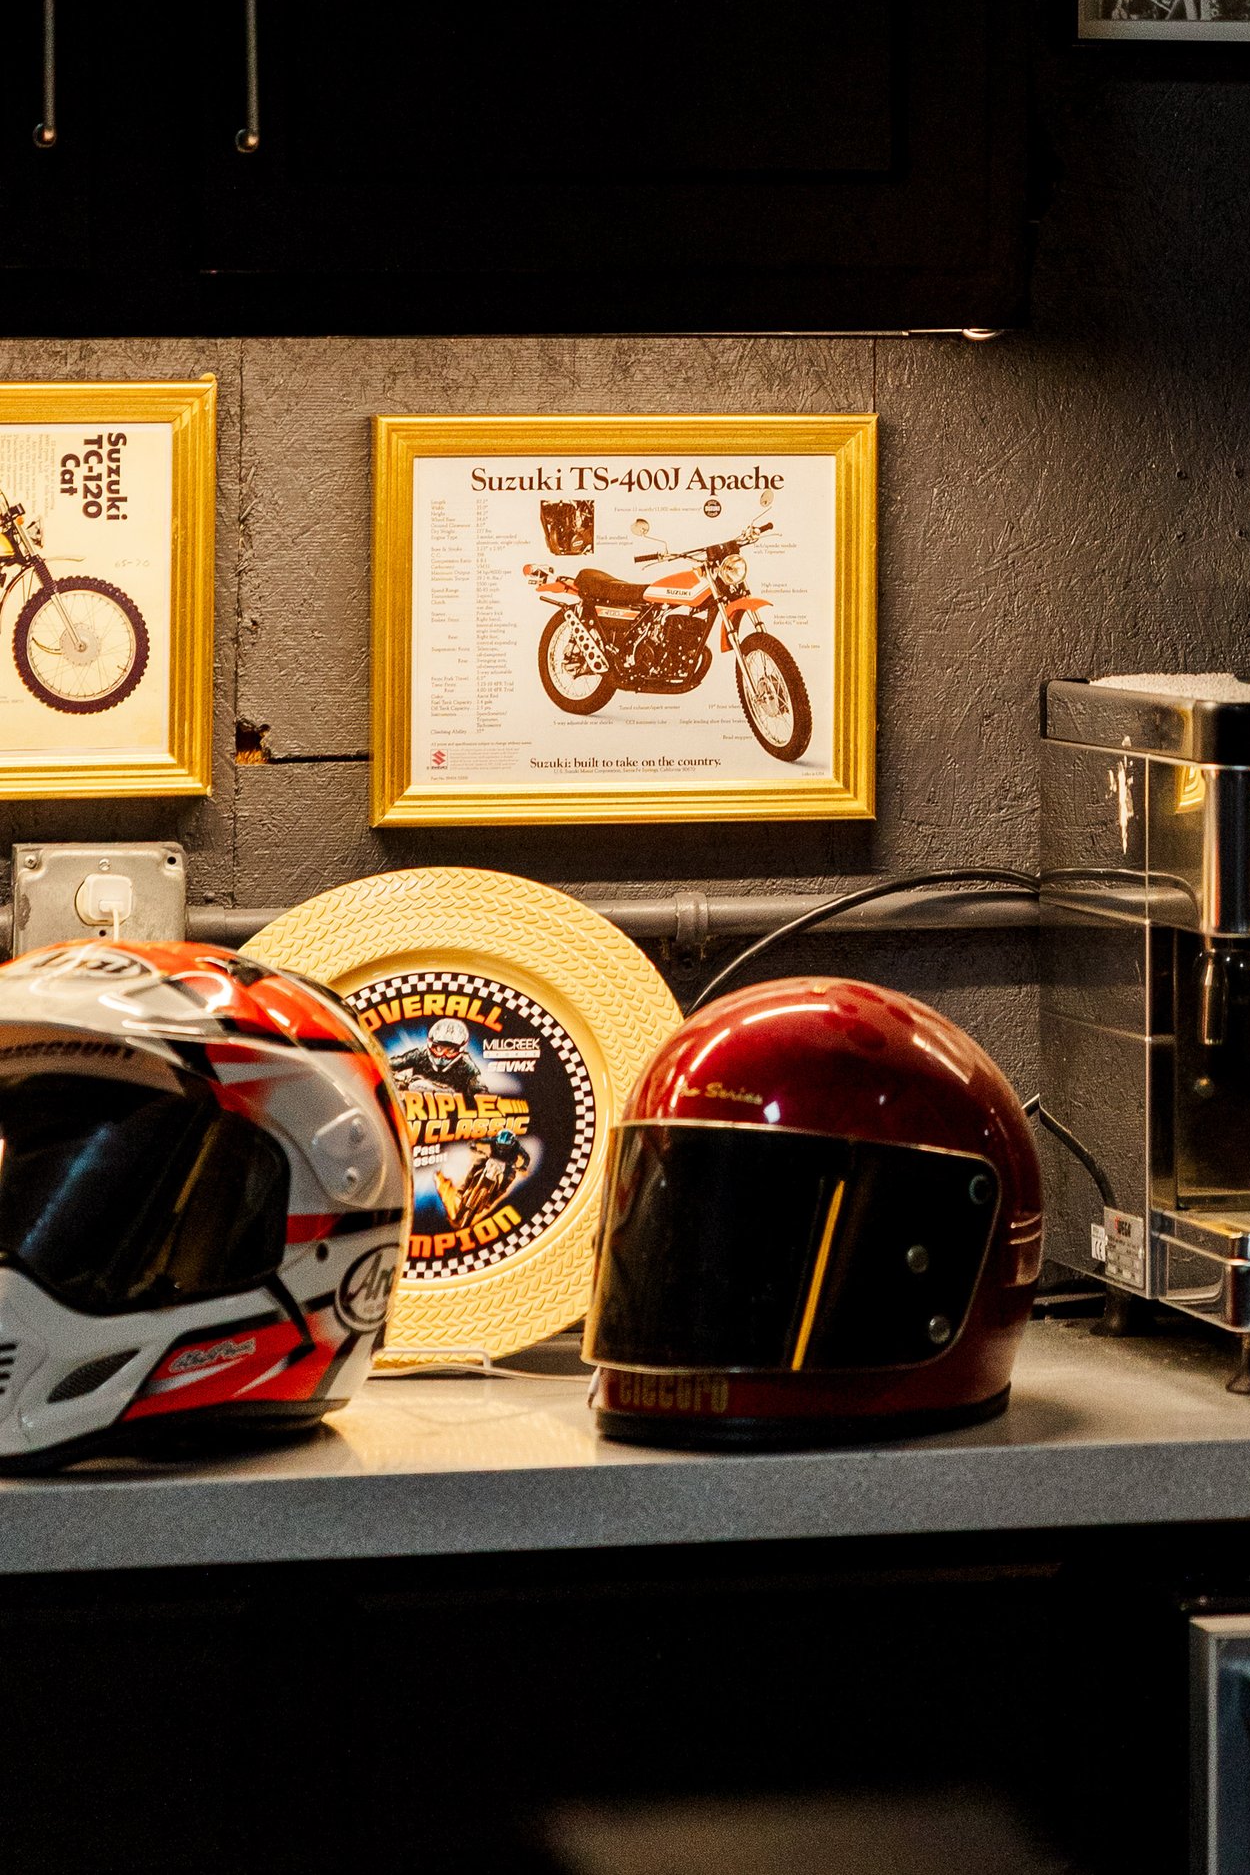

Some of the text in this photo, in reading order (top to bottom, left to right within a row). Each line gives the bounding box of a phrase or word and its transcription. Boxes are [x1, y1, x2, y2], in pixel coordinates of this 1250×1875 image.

[60, 453, 81, 496] Cat
[82, 434, 103, 519] TC-120
[106, 432, 128, 521] Suzuki
[471, 466, 785, 496] Suzuki TS-400J Apache
[530, 757, 571, 770] Suzuki:
[574, 757, 600, 768] built
[602, 759, 614, 768] to
[615, 756, 639, 768] take
[641, 759, 655, 768] on
[658, 756, 675, 767] the
[677, 756, 722, 770] country.
[360, 994, 503, 1032] OVERALL
[483, 1038, 541, 1050] MILLCREEK
[424, 1116, 530, 1144] CLASSIC
[413, 1143, 441, 1157] Past
[410, 1204, 522, 1259] MPION
